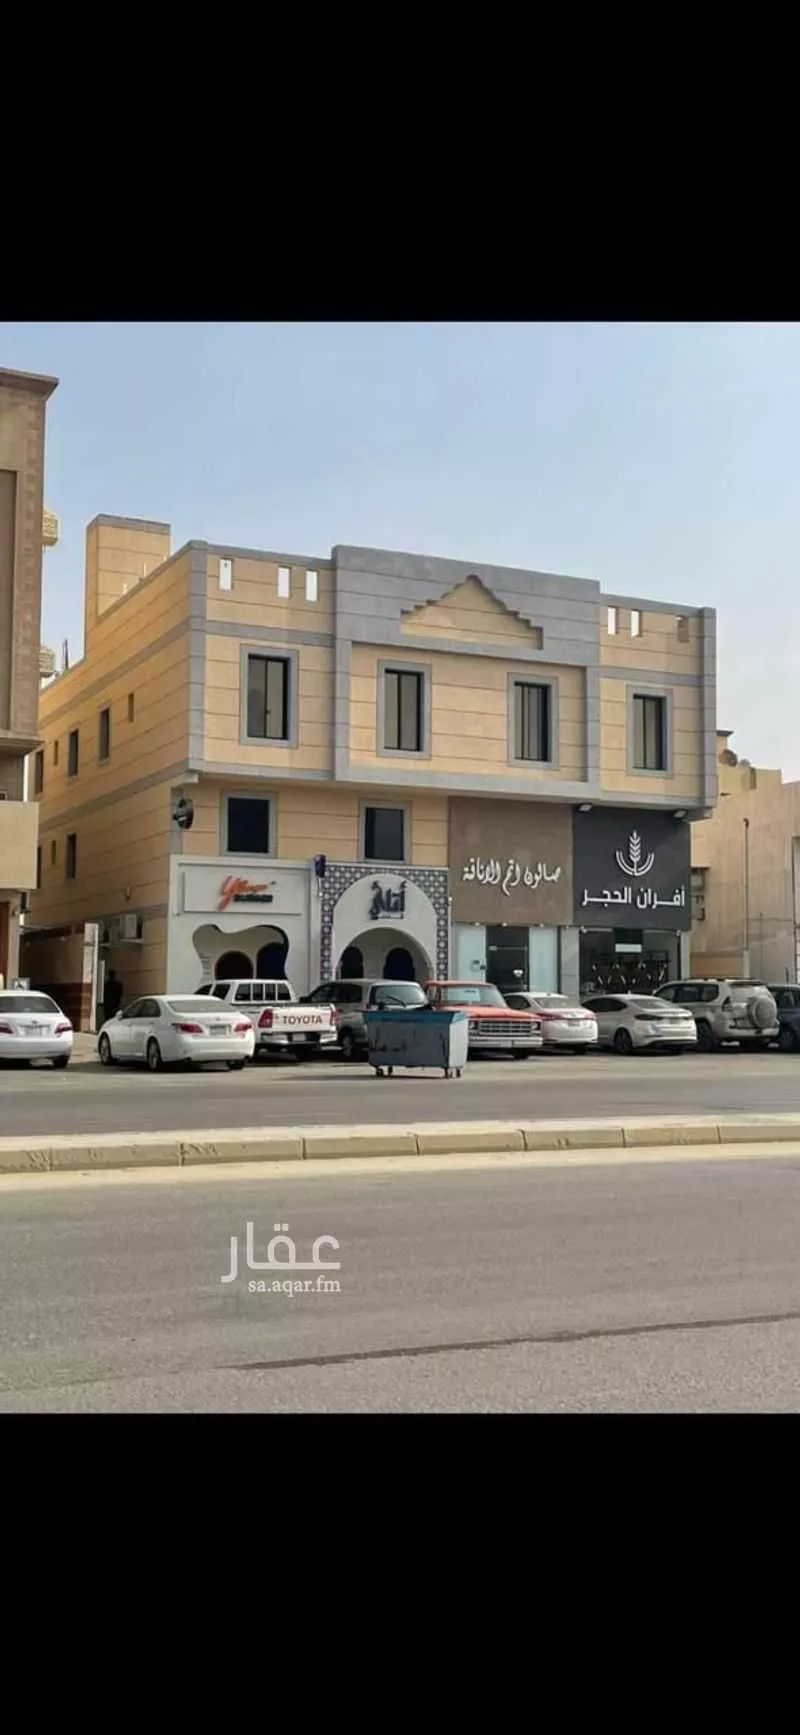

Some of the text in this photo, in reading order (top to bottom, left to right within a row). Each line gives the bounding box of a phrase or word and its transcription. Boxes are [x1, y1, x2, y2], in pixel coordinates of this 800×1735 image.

[524, 861, 561, 889] صالون
[581, 884, 686, 909] أفران الحجر
[283, 1015, 322, 1025] TOYOTA
